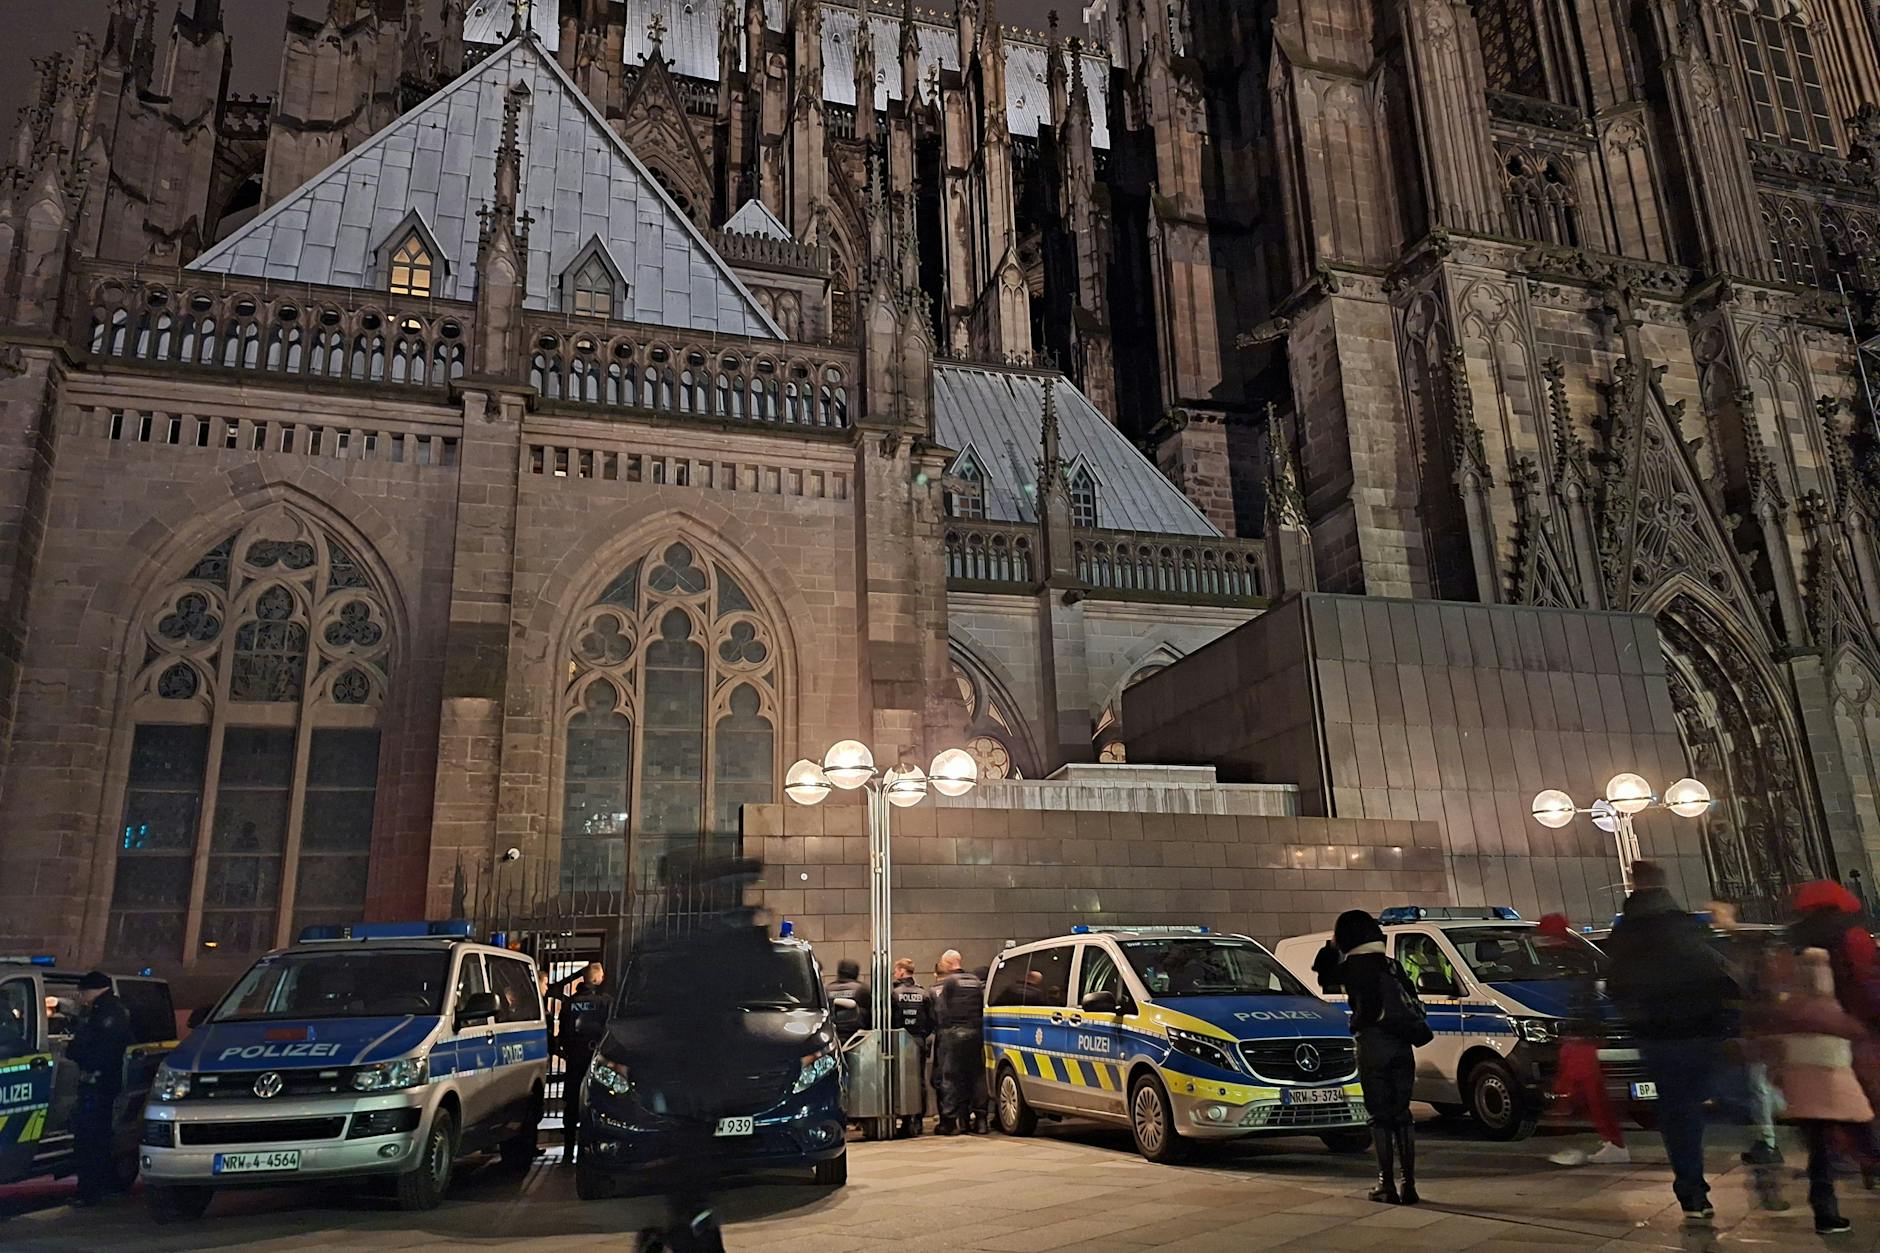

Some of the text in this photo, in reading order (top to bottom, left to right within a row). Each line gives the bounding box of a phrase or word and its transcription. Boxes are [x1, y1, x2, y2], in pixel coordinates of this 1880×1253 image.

[898, 993, 923, 1002] POLIZEI
[1233, 1010, 1323, 1021] POLIZEI
[1078, 1034, 1110, 1053] POLIZEI
[218, 1043, 342, 1061] POLIZEI
[728, 1119, 751, 1133] 939
[223, 1155, 246, 1169] NRW
